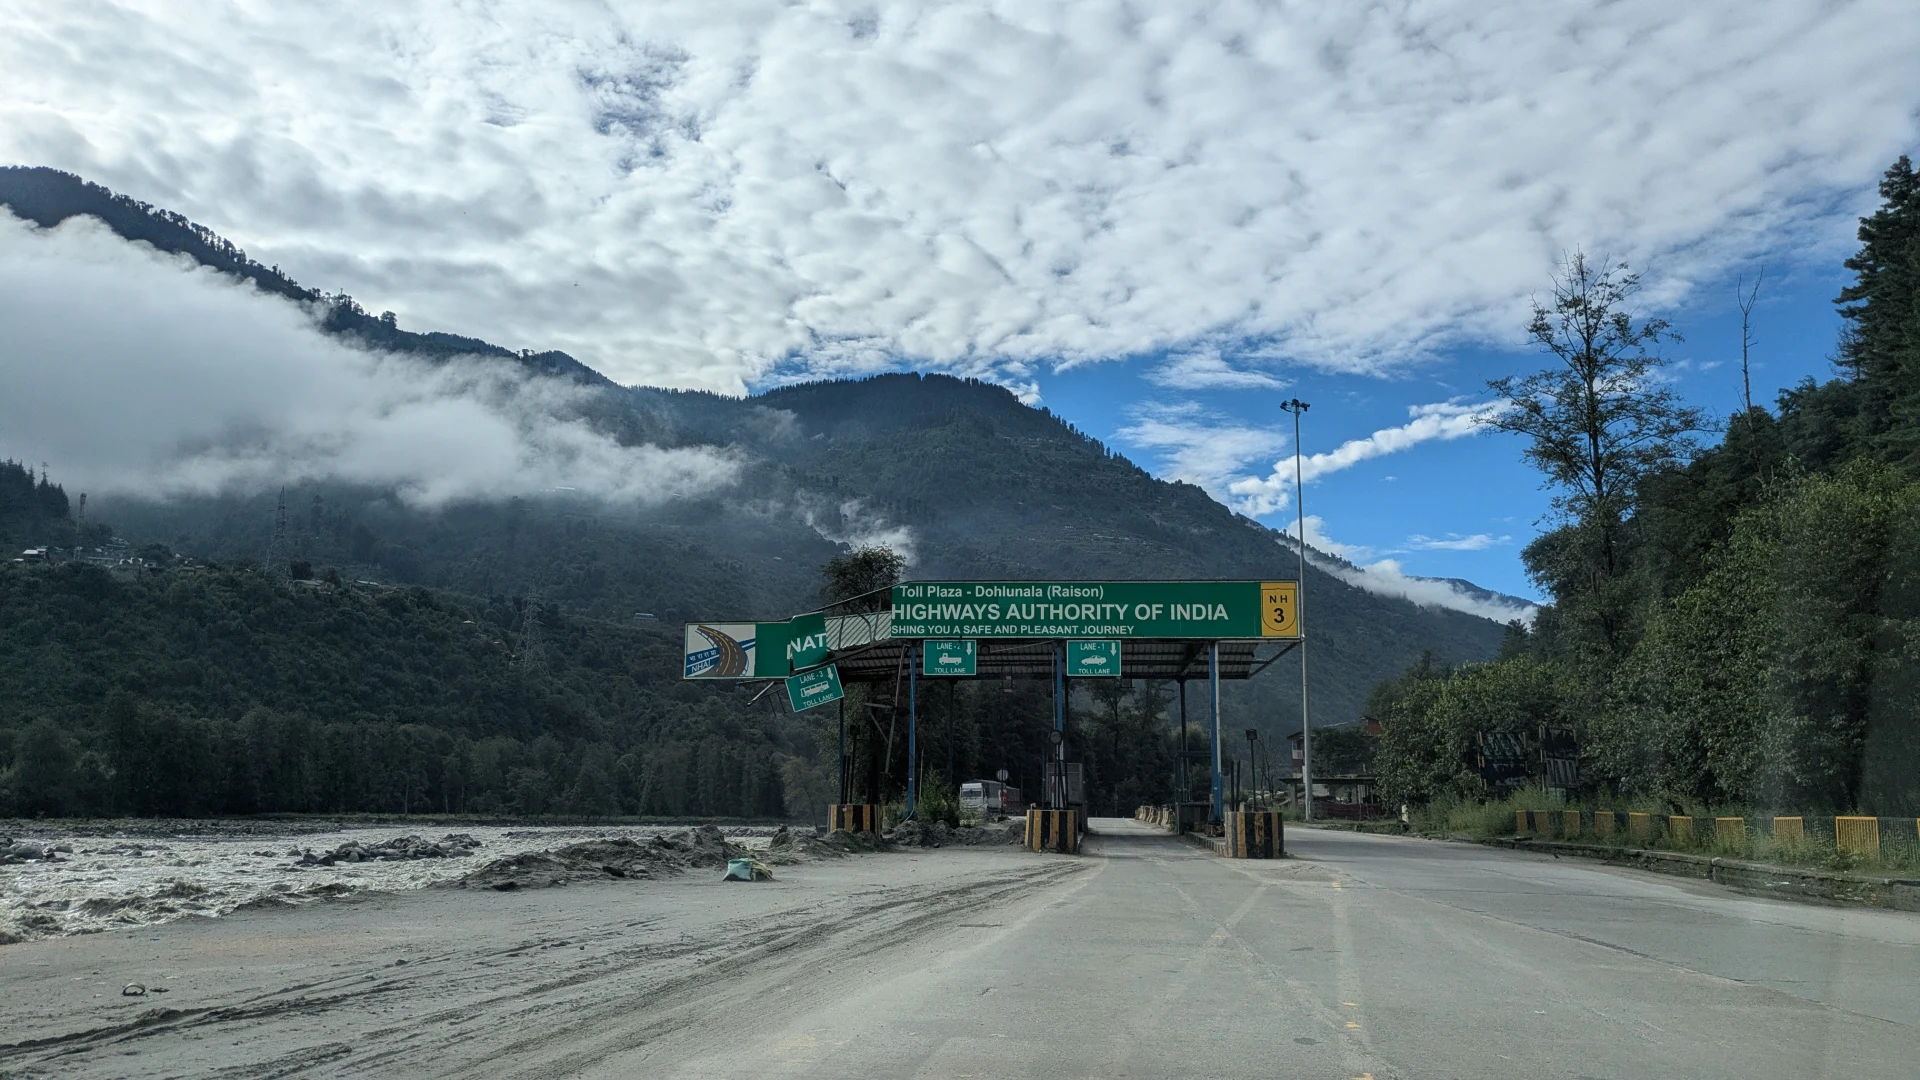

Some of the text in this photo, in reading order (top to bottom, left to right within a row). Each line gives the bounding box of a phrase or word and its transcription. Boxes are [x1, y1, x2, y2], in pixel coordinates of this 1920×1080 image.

[900, 585, 923, 598] Toll
[927, 585, 962, 598] Plaza
[975, 585, 1043, 598] Dohlunala
[1047, 585, 1104, 600] (Raison)
[891, 603, 1229, 621] HIGHWAYS AUTHORITY OF INDIA
[1273, 608, 1285, 623] 3
[891, 625, 1135, 635] SHING YOU A SAFE AND PLEASANT JOURNEY
[936, 642, 953, 650] LANE
[691, 659, 711, 673] NHAI
[800, 672, 815, 684] LANE
[819, 670, 824, 678] 3
[803, 693, 834, 708] TOLL LANE
